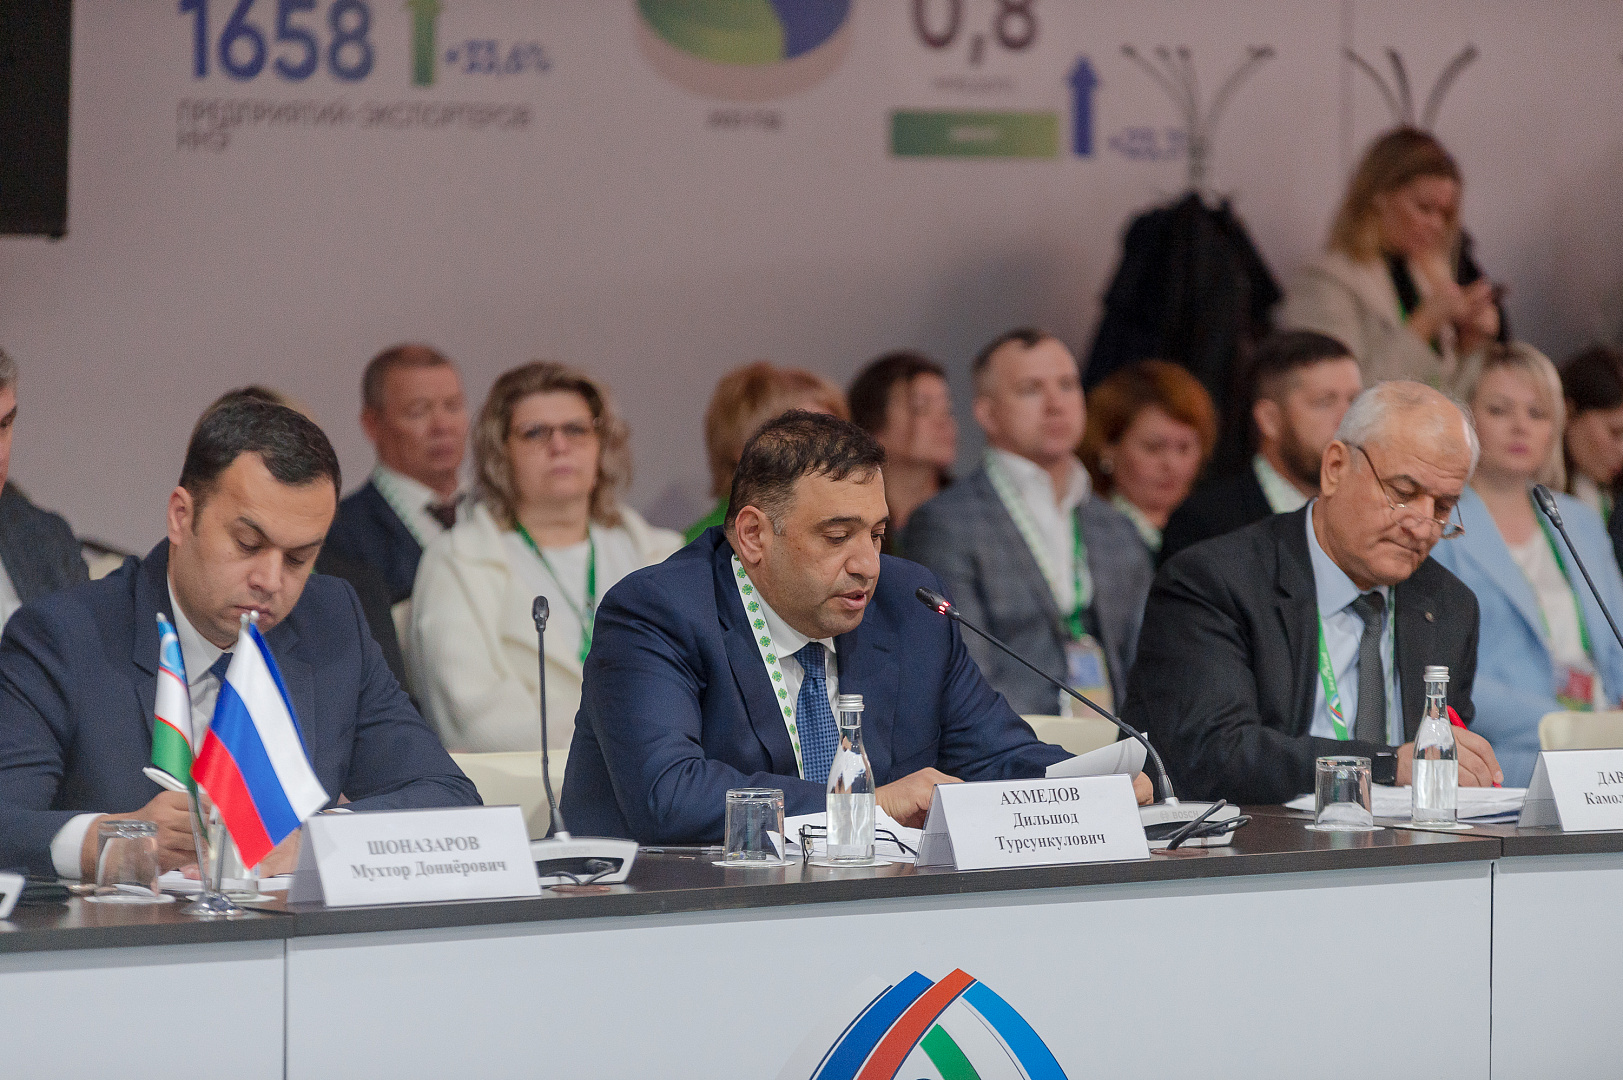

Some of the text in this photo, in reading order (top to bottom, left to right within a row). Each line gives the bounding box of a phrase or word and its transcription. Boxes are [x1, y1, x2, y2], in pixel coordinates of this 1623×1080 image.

[179, 0, 374, 82] 1658
[911, 0, 1037, 66] 0,8
[1000, 787, 1080, 805] АХМЕДОВ
[1013, 812, 1079, 829] Дильшод
[1172, 810, 1199, 820] BOSCH
[367, 836, 480, 855] ШОНАЗАРОВ
[994, 833, 1106, 853] Турсункулович
[350, 859, 507, 881] Мухтор Дониёрович
